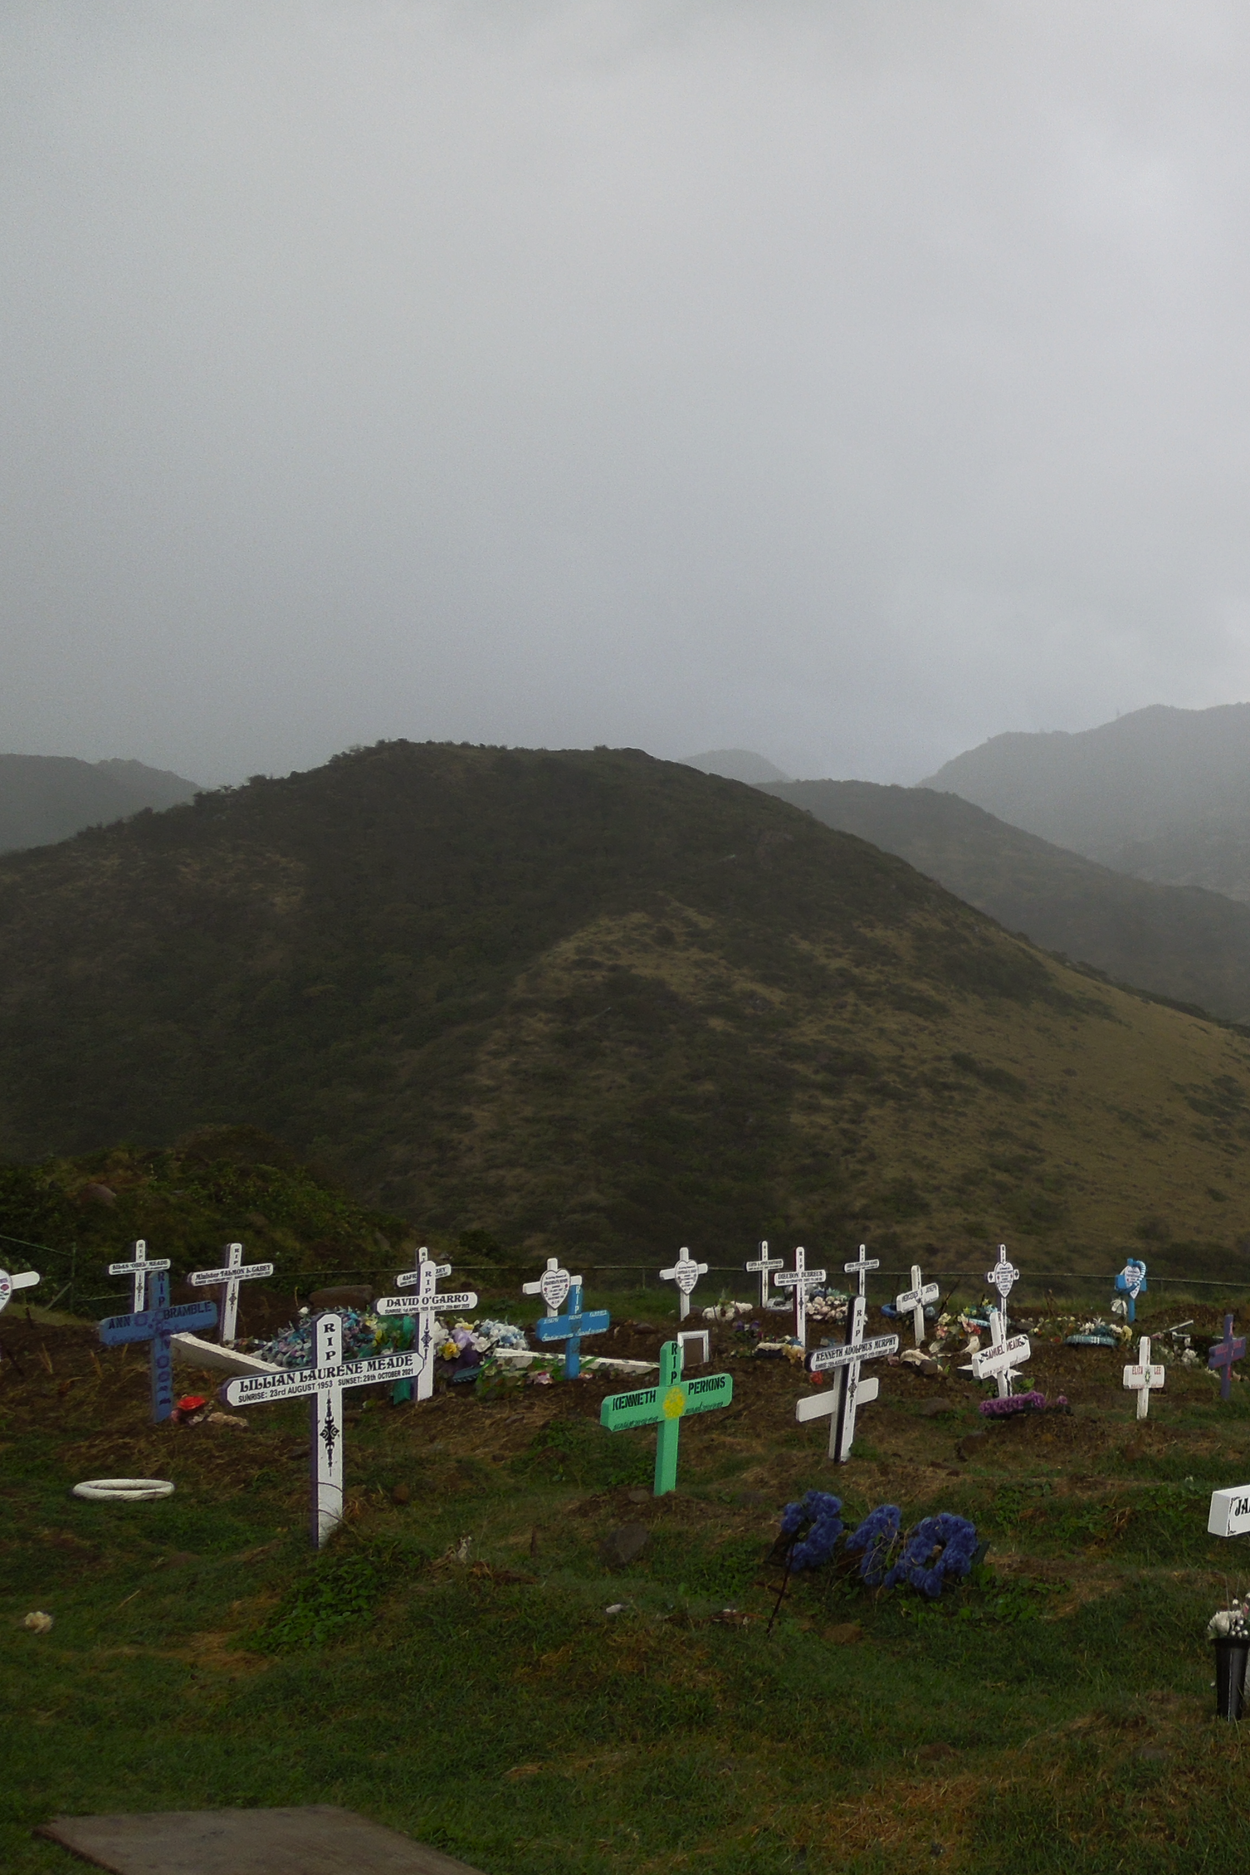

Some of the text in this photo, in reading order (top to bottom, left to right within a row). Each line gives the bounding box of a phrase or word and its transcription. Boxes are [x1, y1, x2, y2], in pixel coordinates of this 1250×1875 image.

[163, 1301, 212, 1320] BRAMBLE
[386, 1294, 469, 1307] DAVID O'GARRO
[324, 1323, 335, 1361] RIP
[816, 1347, 843, 1362] KENNETH
[844, 1342, 873, 1355] ADOLPHUS
[874, 1336, 896, 1349] MURPHY
[238, 1392, 268, 1403] SUNRISE:
[270, 1387, 286, 1398] 23rd
[288, 1383, 316, 1395] AUGUST
[317, 1380, 333, 1392] 1953
[377, 1369, 401, 1380] OCTOBER
[401, 1367, 414, 1377] 2021
[239, 1354, 414, 1393] LILLIAN LAURENE MEADE
[612, 1376, 726, 1411] KENNETH PERKINS
